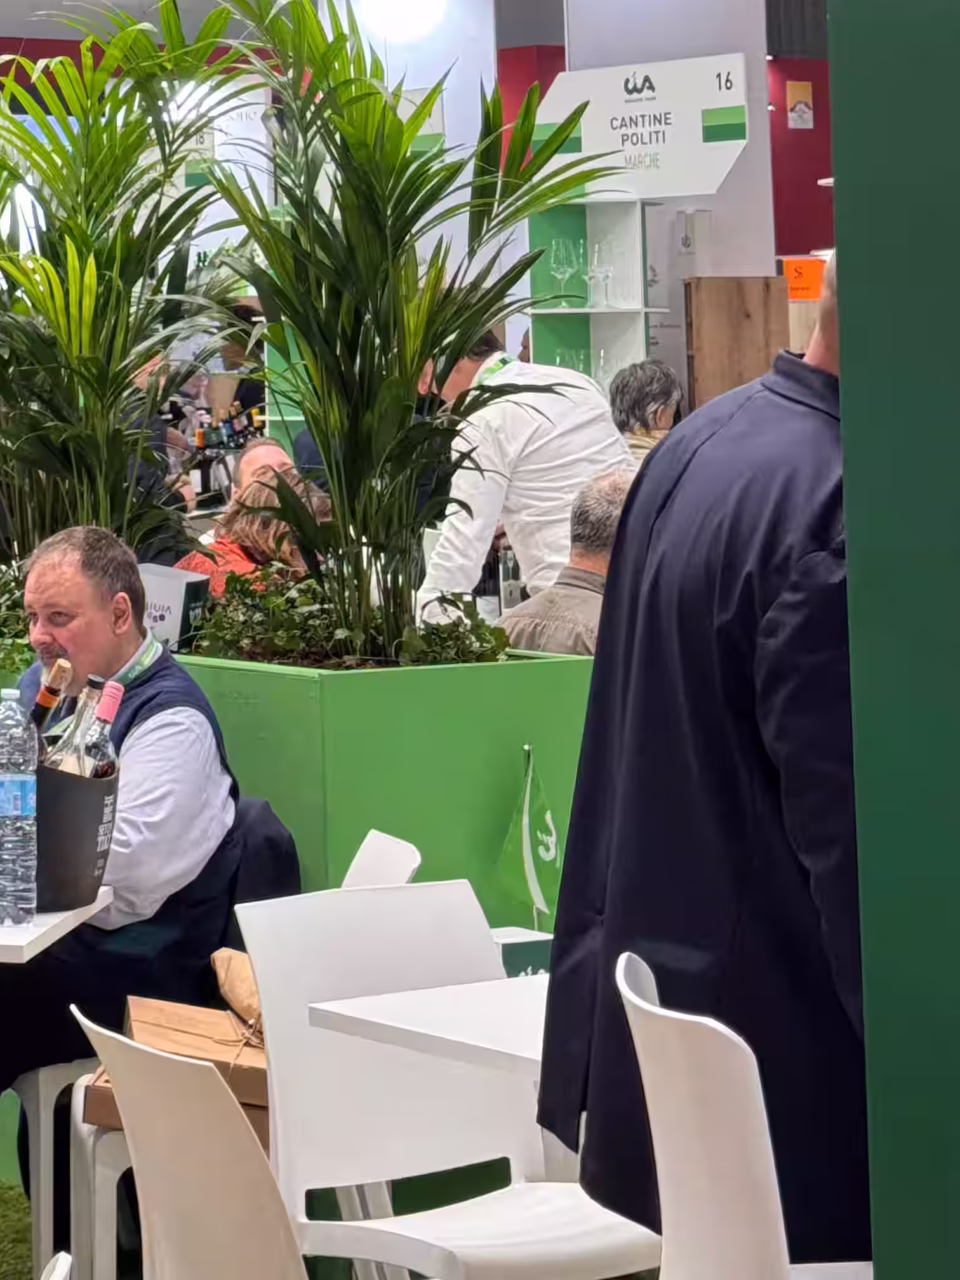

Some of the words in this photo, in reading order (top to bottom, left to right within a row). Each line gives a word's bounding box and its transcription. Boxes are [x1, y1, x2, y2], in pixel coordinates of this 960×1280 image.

[715, 71, 734, 92] 16
[609, 111, 673, 131] CANTINE
[620, 130, 666, 148] POLITI
[623, 152, 661, 170] MARCHE
